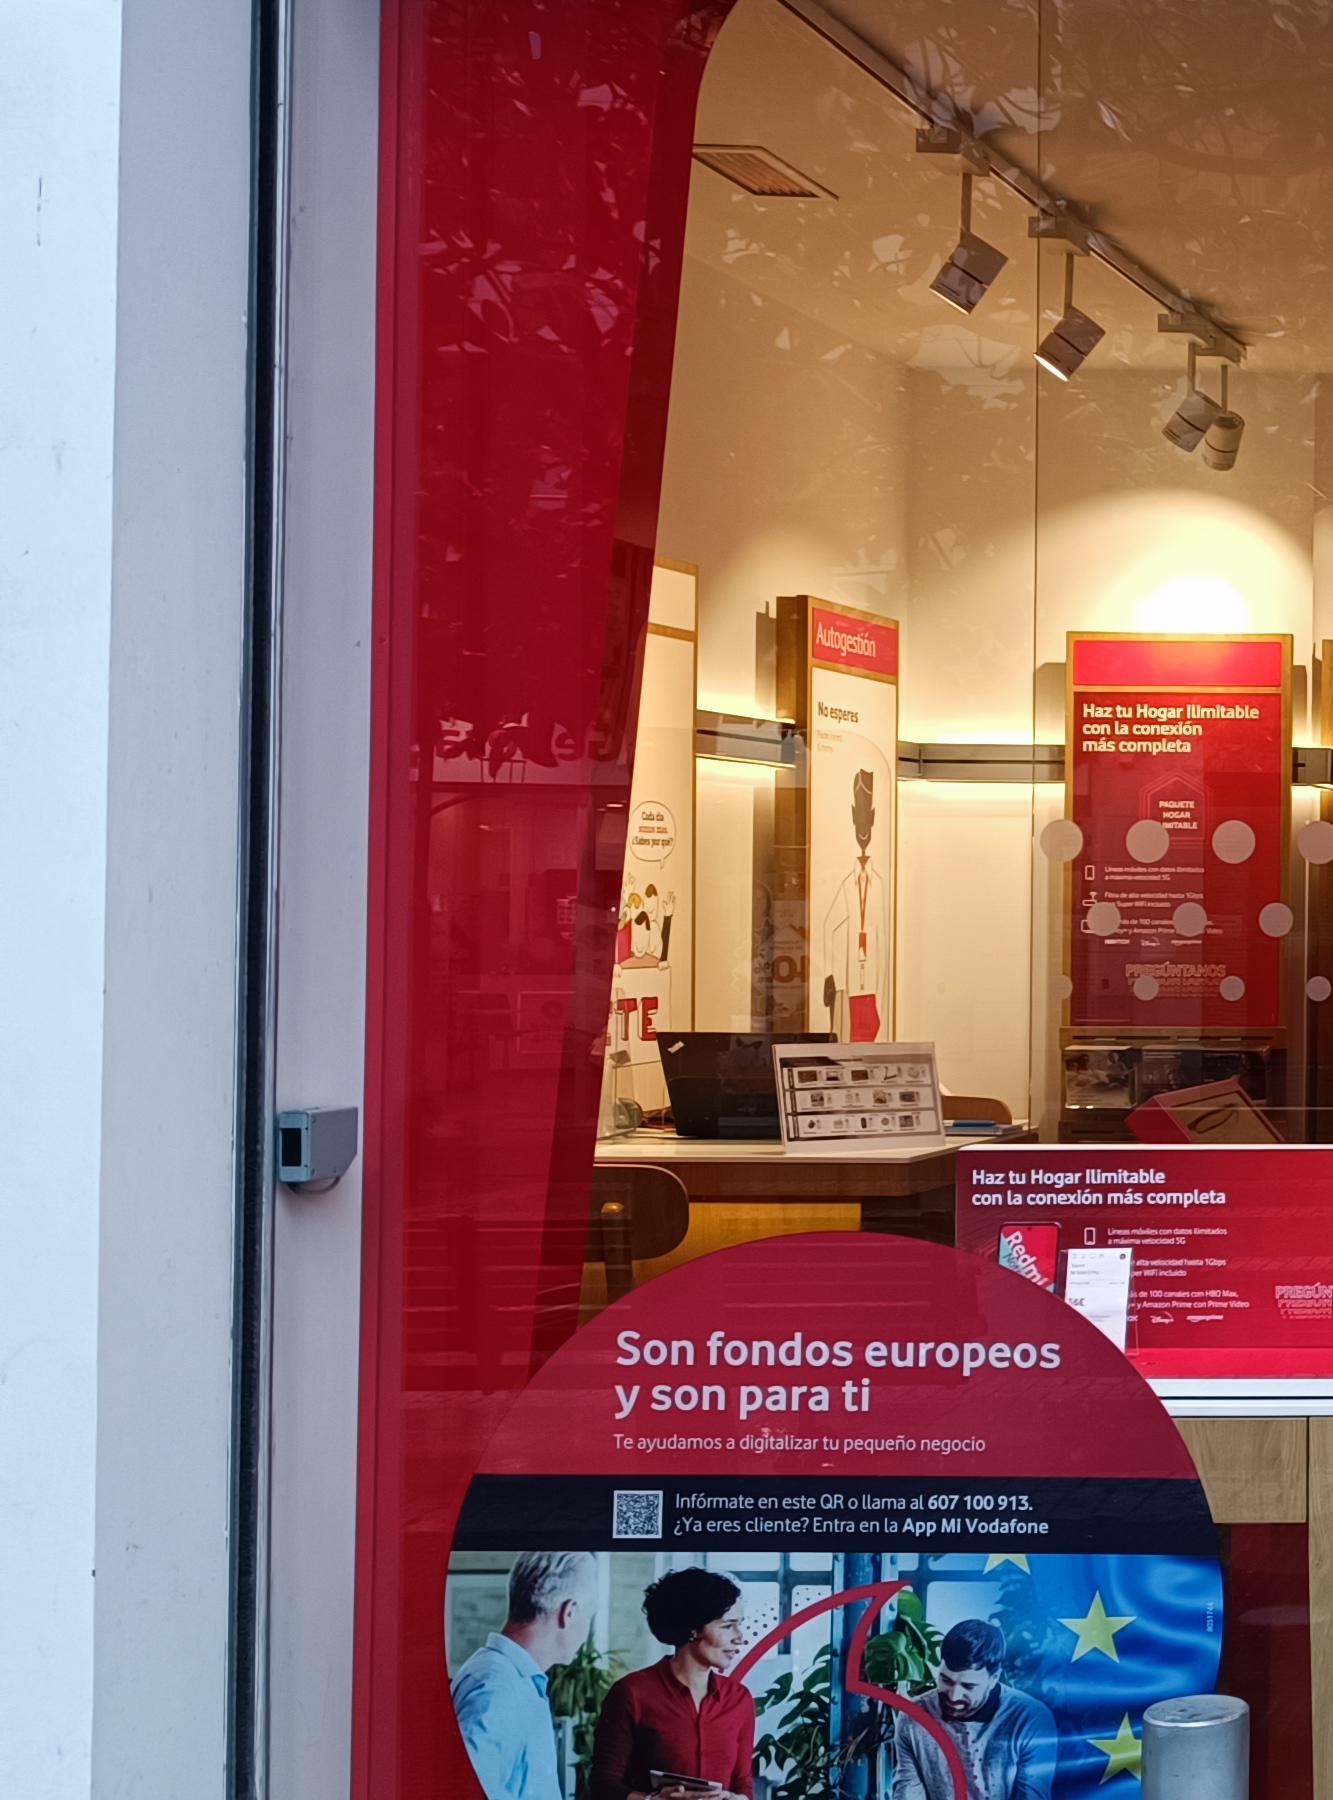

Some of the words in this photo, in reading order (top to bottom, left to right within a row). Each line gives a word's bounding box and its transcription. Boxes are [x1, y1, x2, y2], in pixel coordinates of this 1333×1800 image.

[816, 622, 876, 658] Autogestión
[818, 701, 828, 717] No
[830, 705, 858, 724] esperes
[1083, 703, 1111, 718] Haz
[1116, 705, 1132, 719] tu
[1136, 704, 1182, 722] Hogar
[1187, 704, 1259, 719] Ilimitable
[1083, 723, 1110, 735] con
[1115, 721, 1129, 735] la
[1134, 721, 1202, 736] conexión
[1083, 737, 1115, 753] más
[1119, 738, 1191, 755] completa
[1125, 961, 1226, 977] PREGÚNTANOS
[972, 1169, 1005, 1185] Haz
[1008, 1171, 1026, 1185] tu
[1031, 1169, 1081, 1190] Hogar
[1085, 1168, 1165, 1185] Ilimitable
[972, 1192, 1002, 1206] con
[1007, 1189, 1022, 1206] la
[1026, 1189, 1103, 1206] conexión
[1107, 1189, 1143, 1205] más
[1146, 1190, 1226, 1208] completa
[1176, 1237, 1186, 1245] 5G
[1006, 1230, 1049, 1287] Redmi
[1142, 1300, 1170, 1308] Amazon
[1171, 1300, 1192, 1308] Prime
[1208, 1300, 1228, 1308] Prime
[1230, 1300, 1249, 1308] Video
[1149, 1290, 1163, 1298] 100
[616, 1331, 695, 1367] Son
[707, 1331, 853, 1368] fondos
[864, 1340, 1061, 1376] europeos
[614, 1384, 640, 1419] y
[651, 1383, 726, 1412] son
[740, 1383, 830, 1419] para
[842, 1378, 871, 1412] ti
[613, 1434, 633, 1450] Te
[637, 1434, 722, 1453] ayudamos
[726, 1438, 735, 1451] a
[740, 1433, 819, 1454] digitalizar
[823, 1437, 839, 1451] tu
[844, 1435, 916, 1455] pequeño
[920, 1437, 986, 1455] negocio
[675, 1493, 754, 1510] Infórmate
[758, 1497, 779, 1510] en
[781, 1496, 816, 1510] este
[819, 1494, 844, 1513] QR
[847, 1498, 858, 1510] o
[861, 1494, 906, 1510] llama
[909, 1494, 924, 1510] al
[927, 1495, 959, 1511] 607
[963, 1495, 994, 1512] 100
[997, 1495, 1033, 1512] 913.
[674, 1516, 702, 1536] ¿Ya
[706, 1519, 741, 1533] eres
[745, 1516, 809, 1534] cliente?
[813, 1517, 856, 1534] Entra
[860, 1520, 880, 1534] en
[884, 1517, 898, 1533] la
[902, 1518, 936, 1537] App
[965, 1518, 1049, 1535] Vodafone
